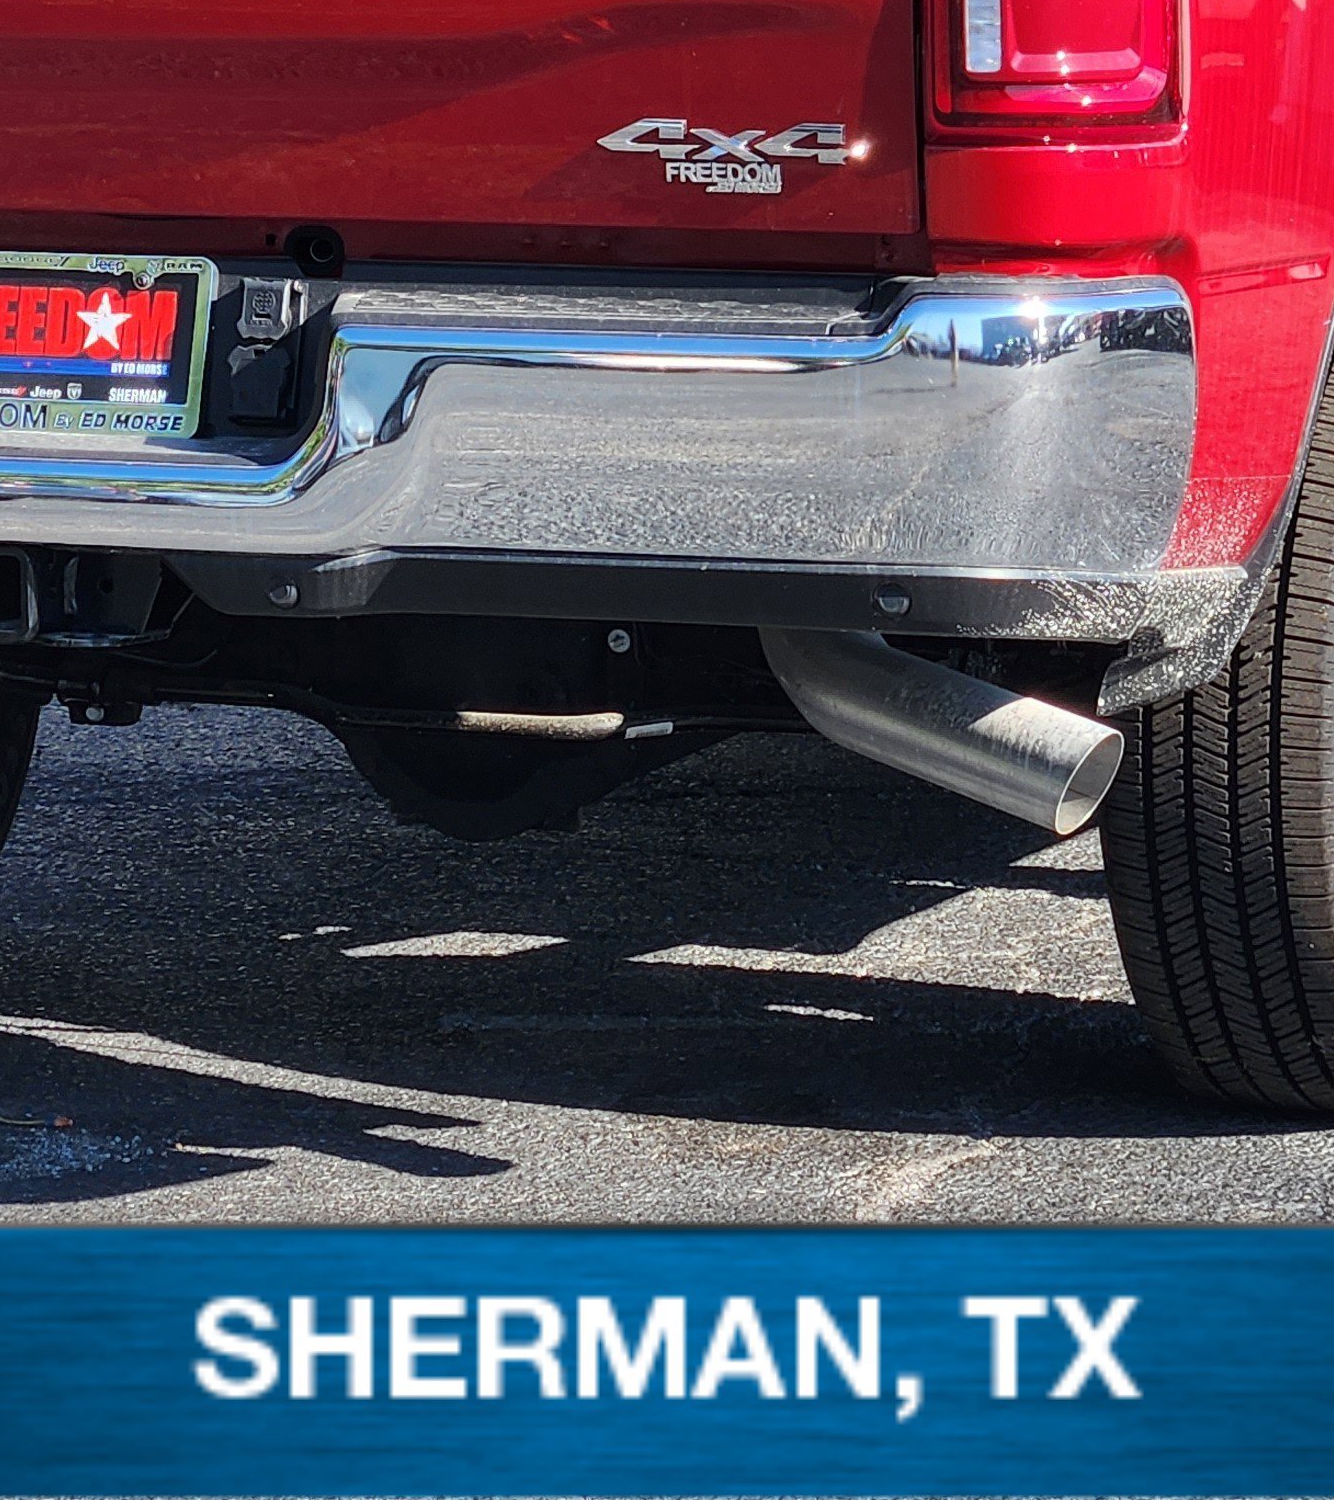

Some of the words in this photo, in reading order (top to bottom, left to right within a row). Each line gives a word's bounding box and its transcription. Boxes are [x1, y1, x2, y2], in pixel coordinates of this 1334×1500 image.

[597, 117, 847, 166] 4x4
[666, 161, 782, 183] FREEDOM
[87, 257, 126, 273] Jeep
[166, 262, 204, 271] RAM
[111, 362, 123, 374] BY
[124, 362, 136, 375] ED
[137, 362, 168, 376] MORSE
[30, 385, 63, 400] Jeep
[109, 386, 168, 404] SHERMAN
[79, 411, 107, 429] ED
[111, 413, 184, 432] MORSE
